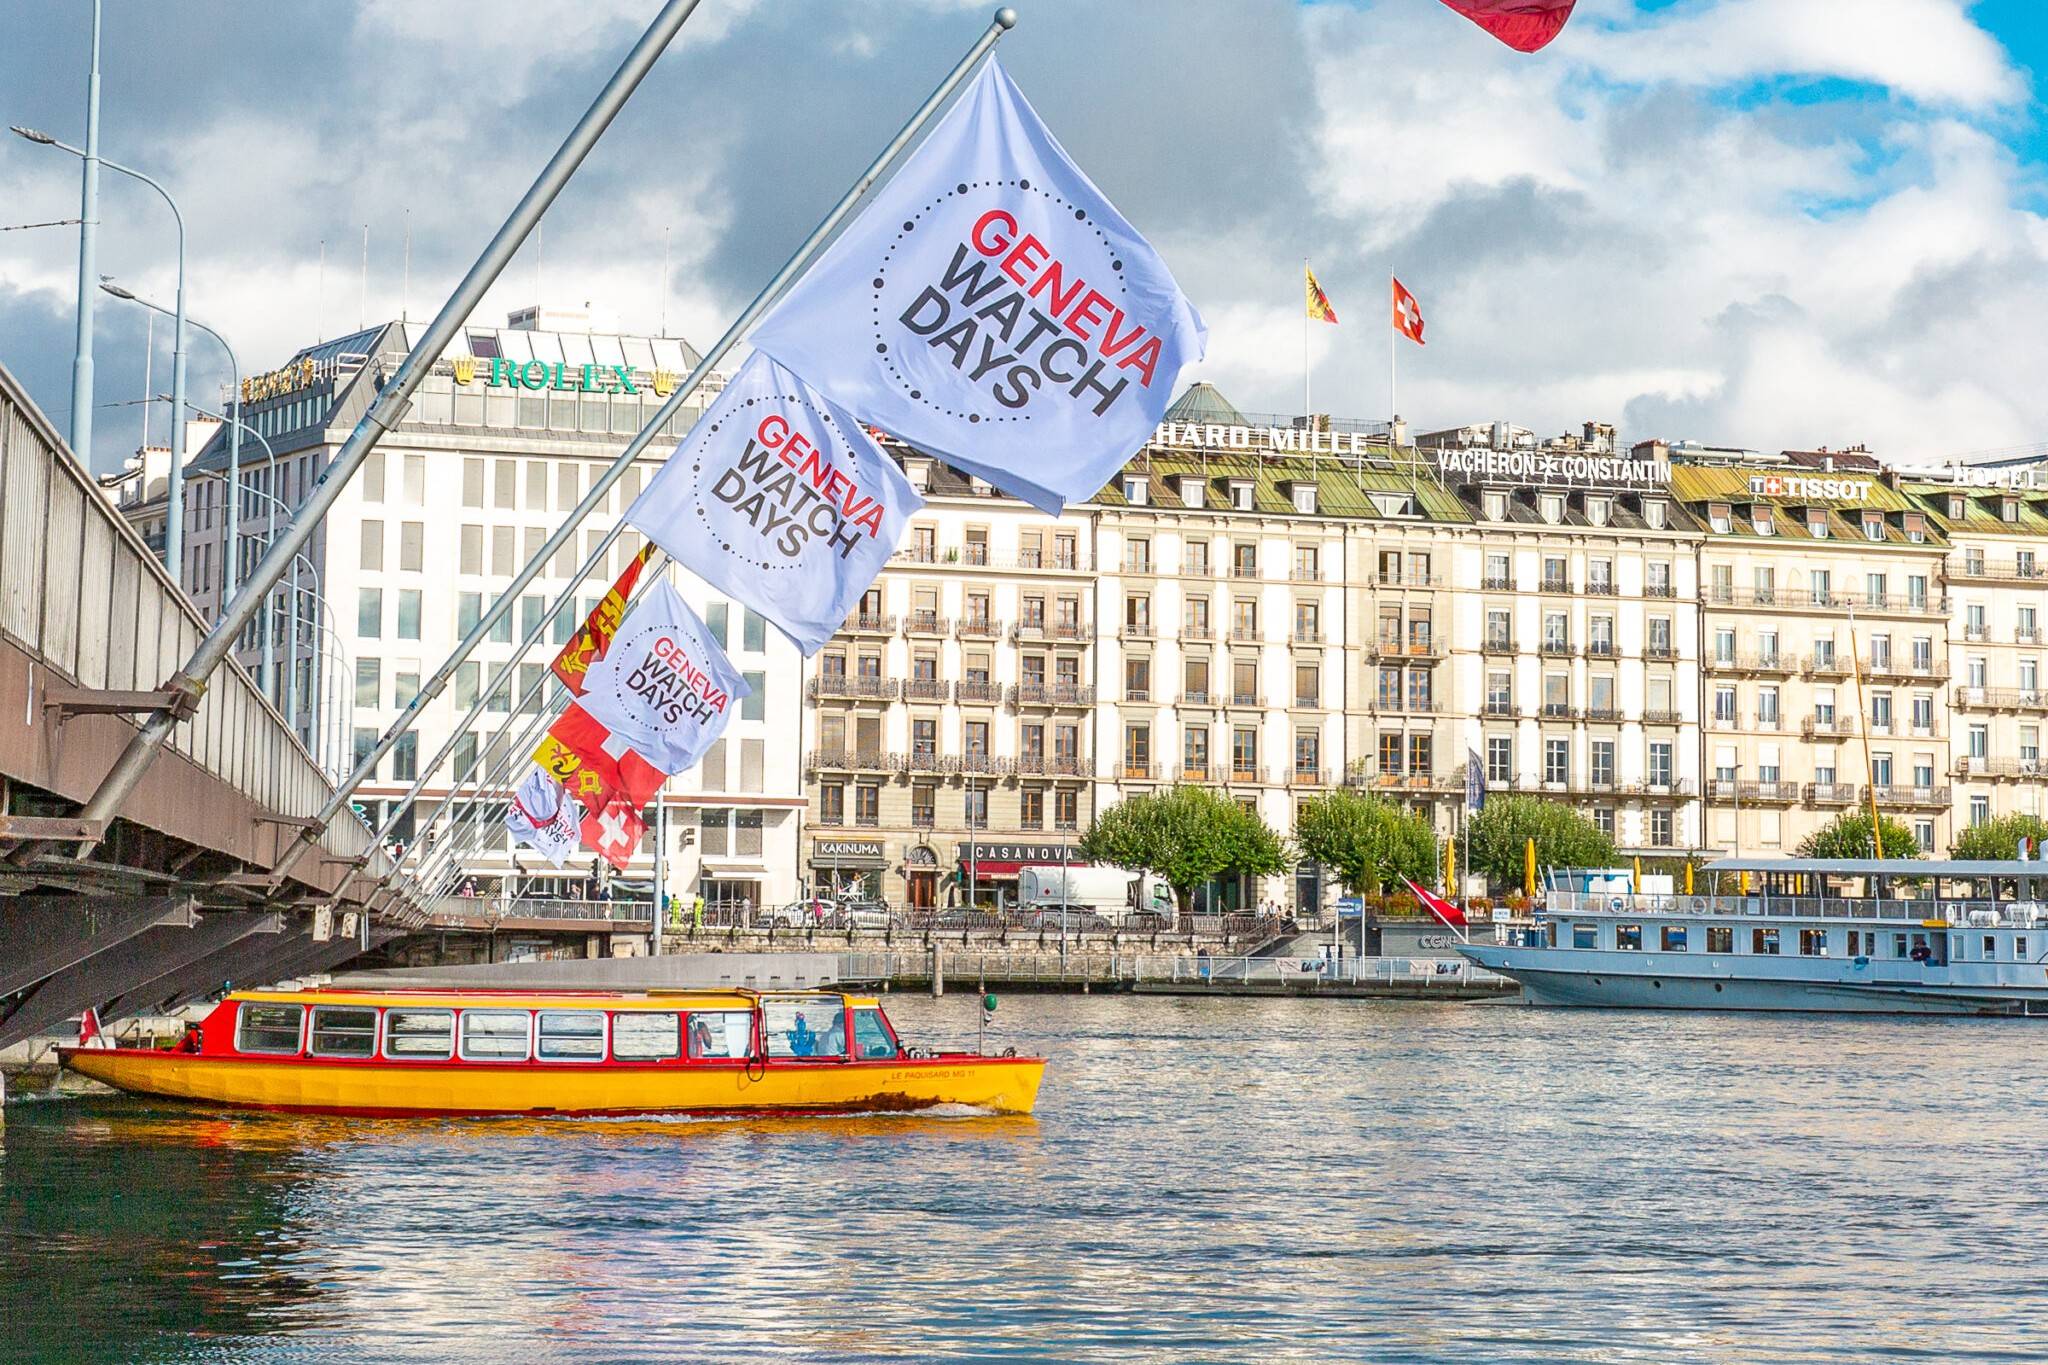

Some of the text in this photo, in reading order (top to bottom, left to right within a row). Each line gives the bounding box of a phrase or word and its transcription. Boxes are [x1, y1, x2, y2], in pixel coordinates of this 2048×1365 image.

[939, 242, 1130, 418] WATCH
[971, 209, 1163, 389] GENEVA
[487, 357, 639, 395] ROLEX
[898, 285, 1042, 408] DAYS
[1155, 422, 1368, 455] HARD MILLE
[1436, 448, 1673, 483] VACHERON CONSTANTIN
[711, 467, 809, 557] DAYS
[738, 438, 862, 560] WATCH
[757, 415, 885, 539] GENEVA
[1782, 477, 1873, 501] TISSOT
[625, 668, 683, 724] DAYS
[641, 651, 714, 726] WATCH
[654, 637, 728, 714] GENEVA
[821, 842, 880, 854] KAKINUMA
[975, 846, 1073, 860] CASANOVA
